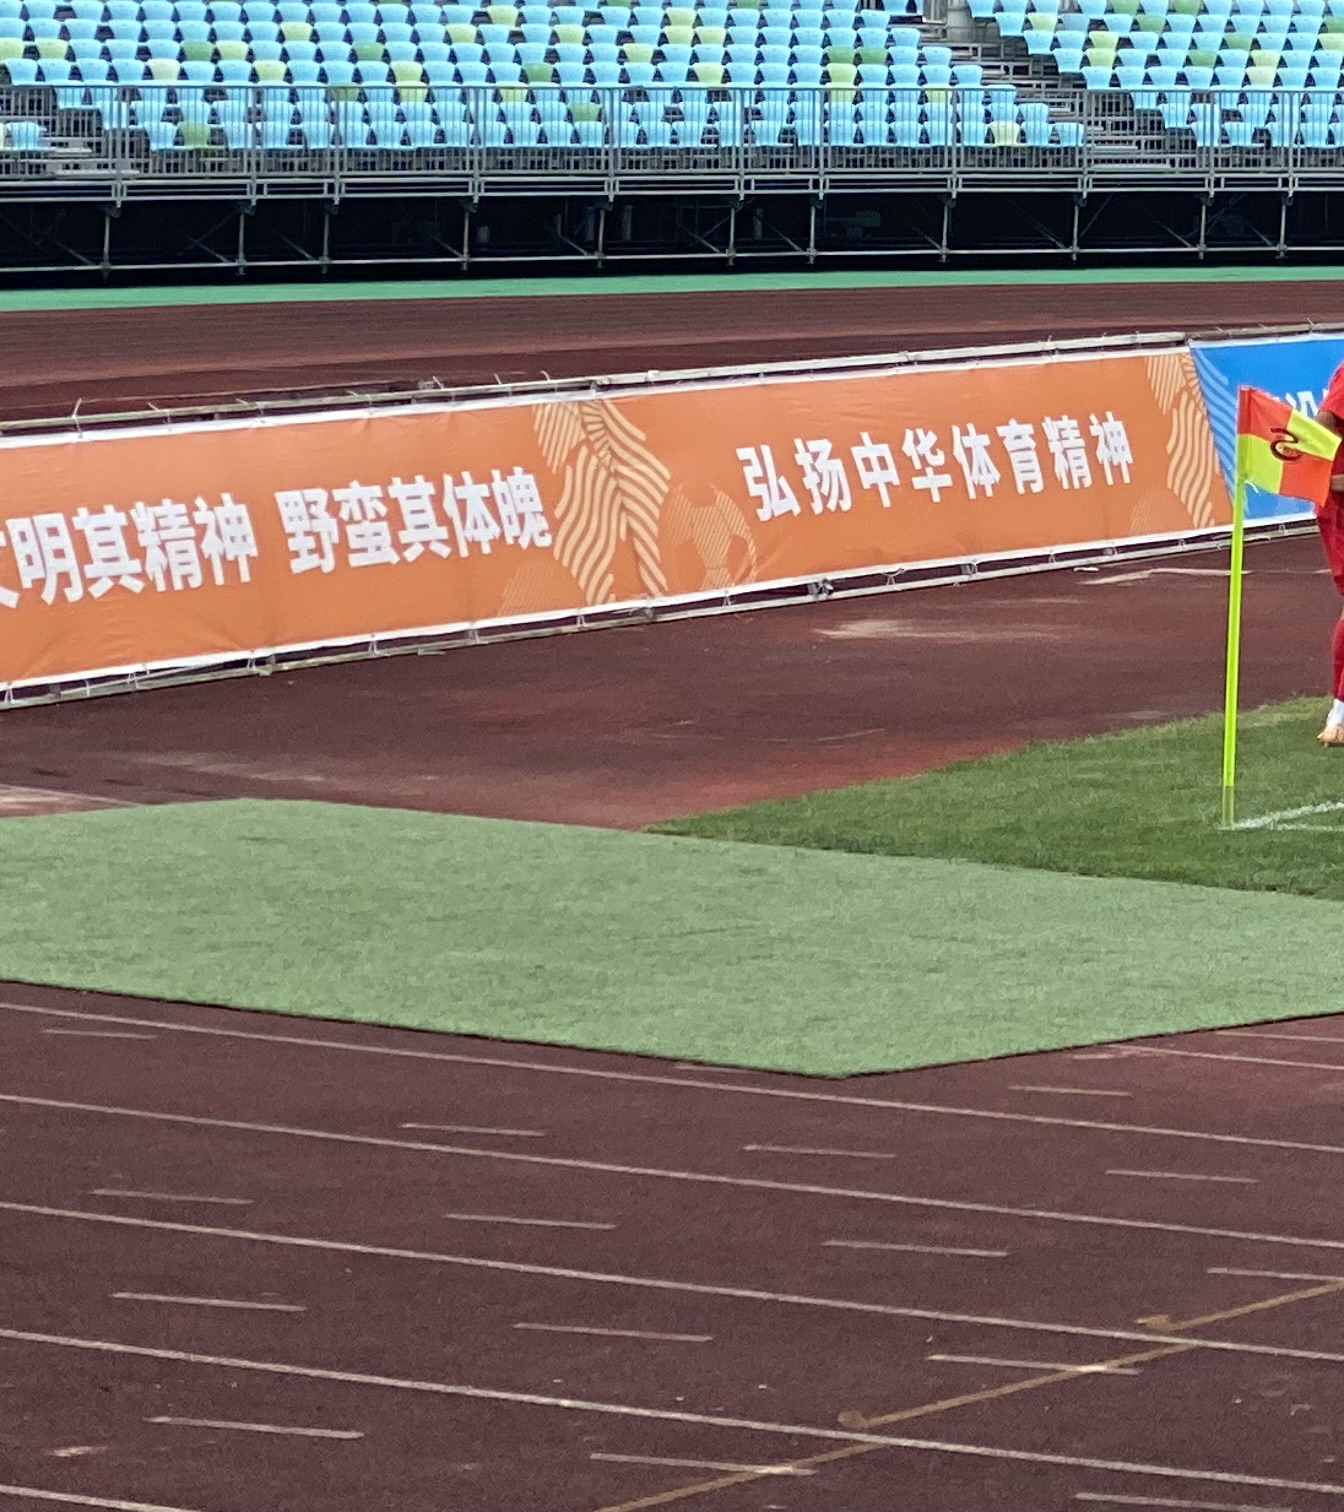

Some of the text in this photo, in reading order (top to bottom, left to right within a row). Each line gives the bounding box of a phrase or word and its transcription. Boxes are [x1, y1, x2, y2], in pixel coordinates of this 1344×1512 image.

[735, 411, 1133, 521] 弘扬中华体育精神
[0, 466, 552, 608] 明其精神 野蛮其体魄
